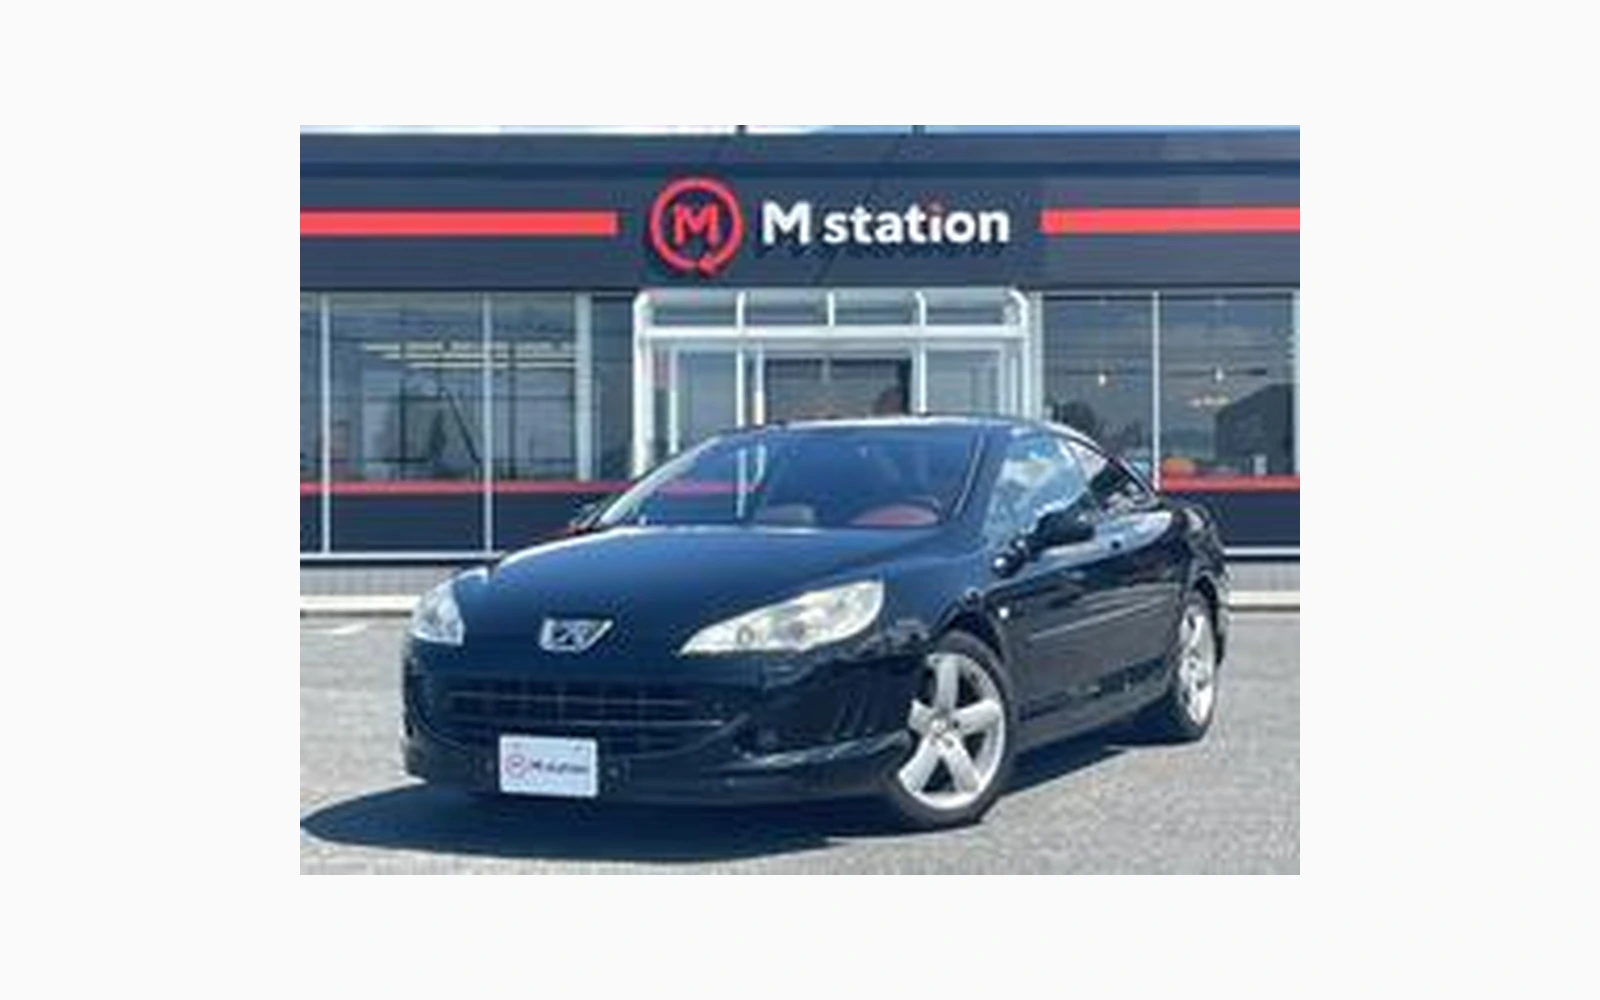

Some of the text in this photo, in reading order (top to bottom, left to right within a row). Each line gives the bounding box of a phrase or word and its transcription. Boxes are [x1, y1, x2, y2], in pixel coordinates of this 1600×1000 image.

[674, 203, 719, 246] M
[763, 202, 1010, 243] M station
